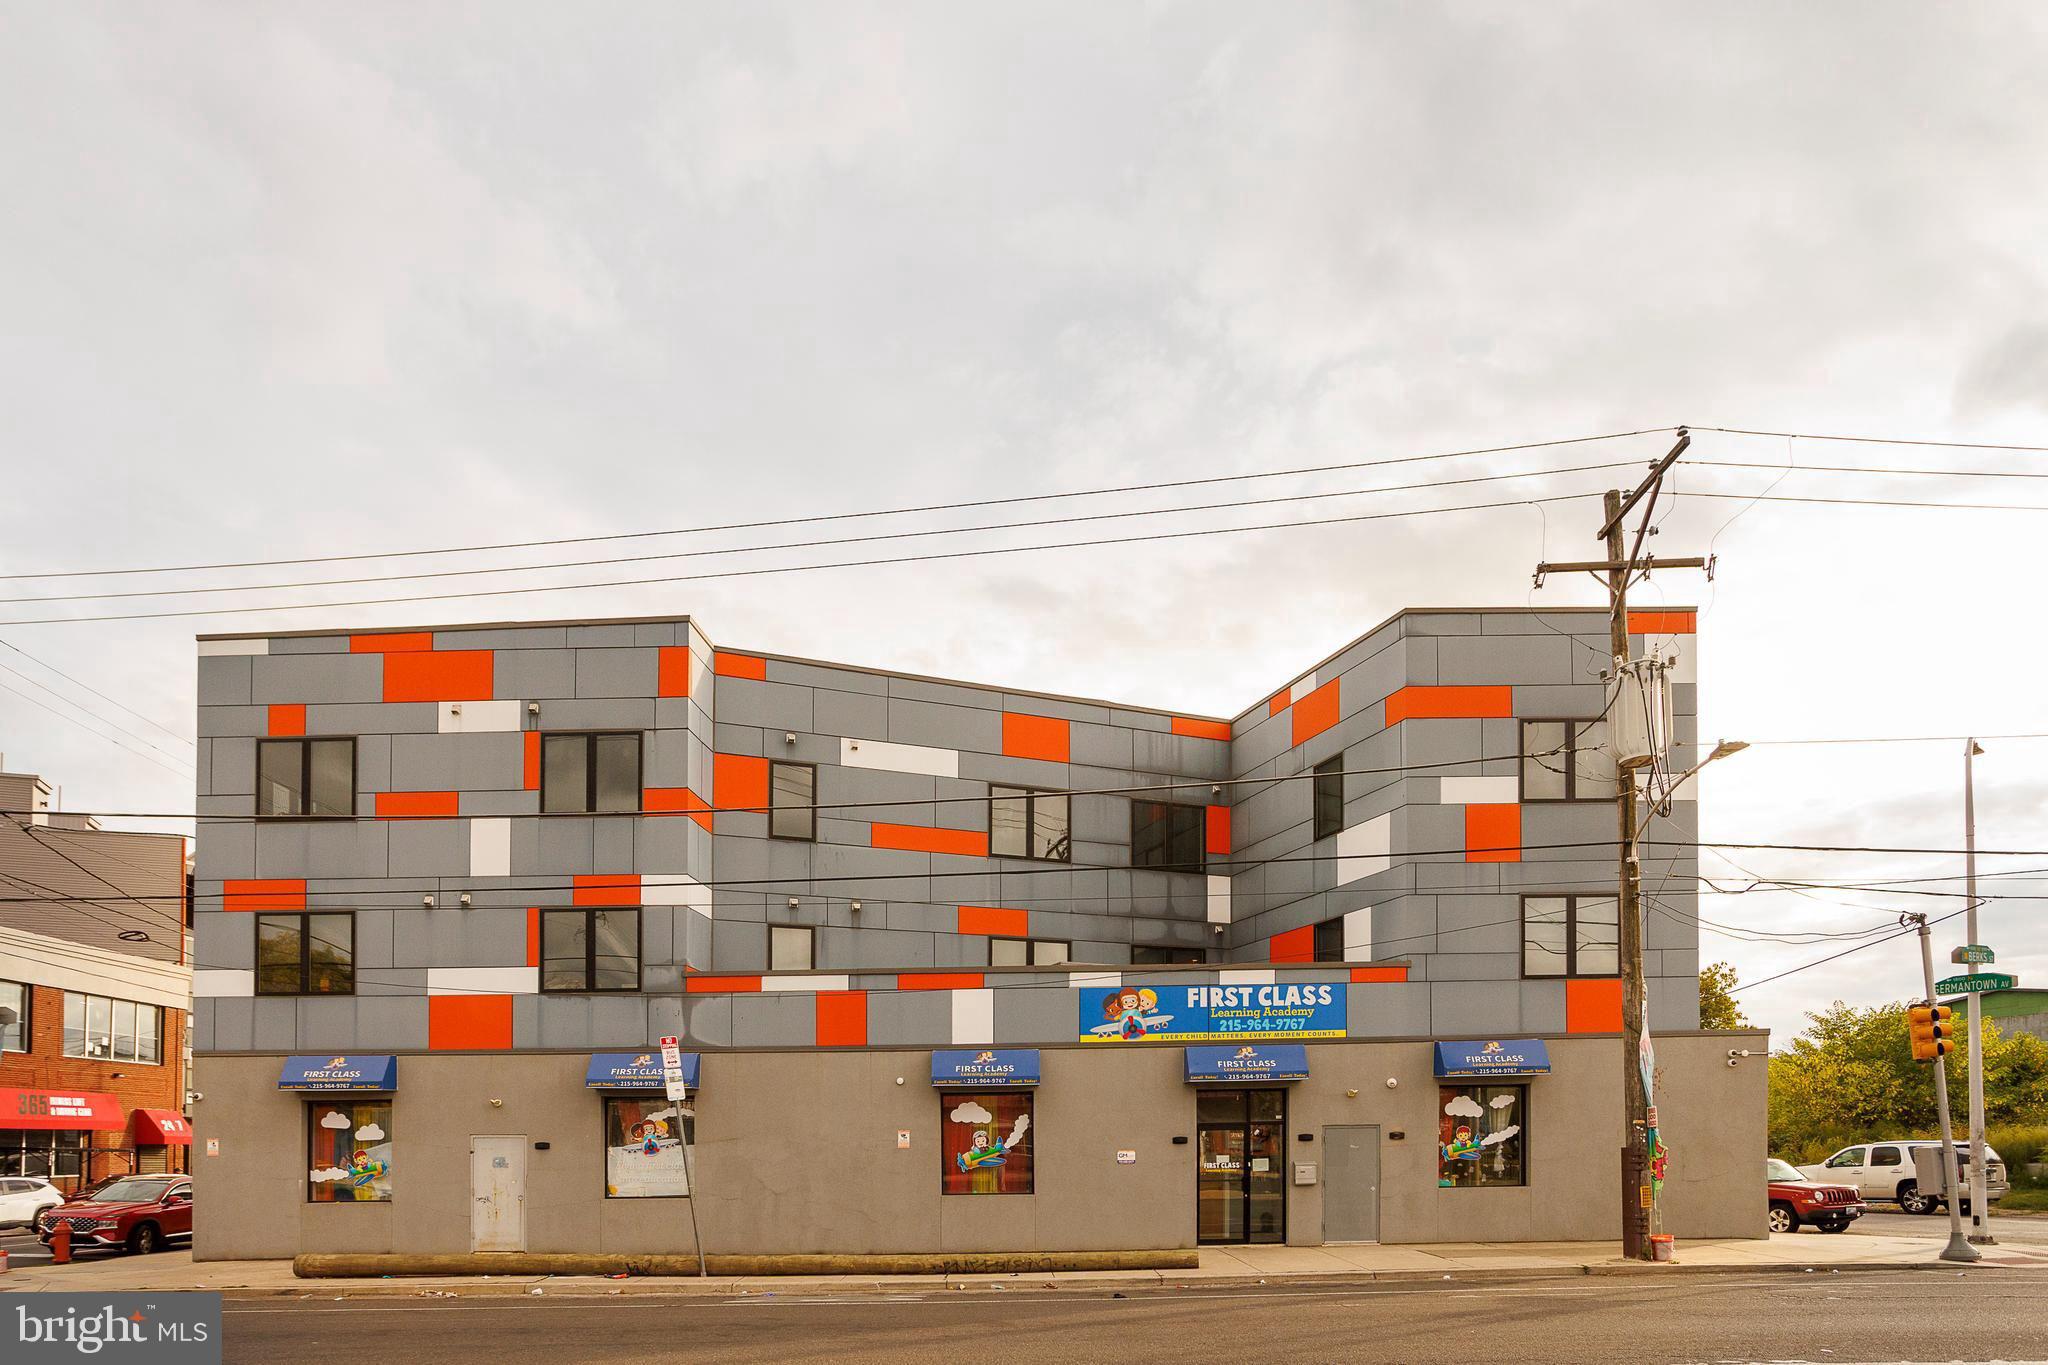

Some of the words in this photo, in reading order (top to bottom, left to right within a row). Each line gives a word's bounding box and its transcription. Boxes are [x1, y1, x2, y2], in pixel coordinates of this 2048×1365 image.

[1968, 951, 1988, 962] BERKS
[1935, 978, 1998, 994] GERMANTOWN
[2000, 980, 2010, 988] AV
[1187, 986, 1254, 1008] FIRST
[1257, 984, 1333, 1007] CLASS
[1210, 1008, 1262, 1019] Learning
[1263, 1005, 1315, 1018] Academy
[1219, 1018, 1306, 1032] 215-964-9767
[1217, 1060, 1244, 1068] FIRST
[1246, 1059, 1276, 1067] CLASS
[1465, 1055, 1492, 1063] FIRST
[1494, 1054, 1524, 1062] CLASS
[303, 1070, 330, 1078] FIRST
[331, 1070, 361, 1078] CLASS
[955, 1065, 983, 1073] FIRST
[984, 1064, 1015, 1072] CLASS
[17, 1093, 49, 1115] 365
[1220, 1161, 1240, 1169] CLASS
